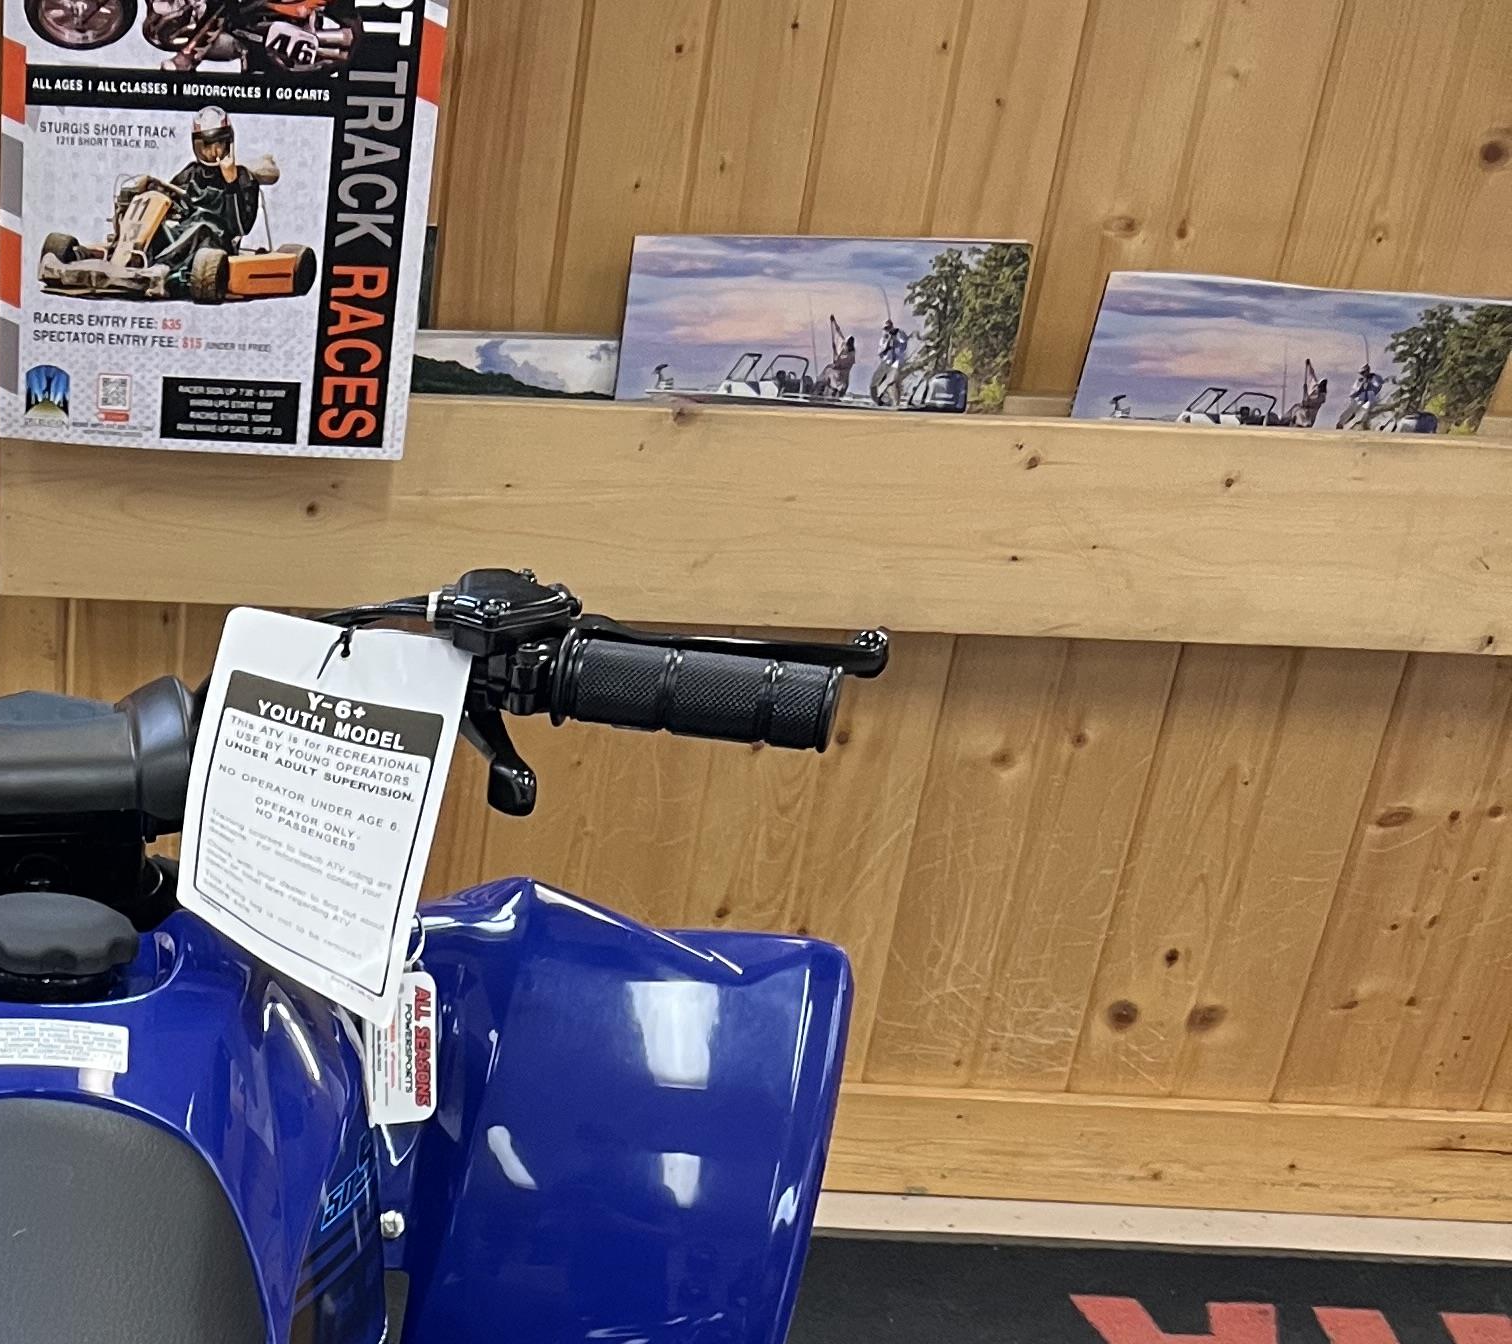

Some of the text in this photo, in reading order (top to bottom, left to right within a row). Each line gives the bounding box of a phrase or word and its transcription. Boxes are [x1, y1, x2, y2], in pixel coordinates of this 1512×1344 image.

[32, 78, 330, 101] ALL AGES ALL CLASSES MOTORCYCLES GO CARTS
[39, 121, 177, 139] STURGIS SHORT TRACK
[334, 60, 409, 249] TRACK
[33, 312, 85, 327] RACERS
[88, 314, 128, 329] ENTRY
[130, 316, 159, 330] FEE:
[33, 330, 106, 345] SPECTATOR
[108, 333, 148, 348] ENTRY
[151, 335, 179, 349] FEE:
[317, 265, 389, 441] RACES
[258, 699, 404, 750] YOUTH MODEL
[307, 692, 366, 719] Y-6+
[225, 739, 269, 760] UNDER
[275, 757, 318, 776] ADULT
[231, 716, 421, 773] This ATV is for RECREATIONAL
[237, 730, 409, 786] USE BY YOUNG OPERATORS
[218, 764, 236, 775] NO
[241, 774, 305, 802] OPERATOR
[311, 794, 353, 818] UNDER
[357, 811, 383, 827] AGE
[255, 796, 318, 826] OPERATOR
[255, 807, 356, 851] NO PASSENGERS
[405, 1003, 413, 1093] POWERSPORTS
[415, 985, 432, 1107] ALL SEASONS
